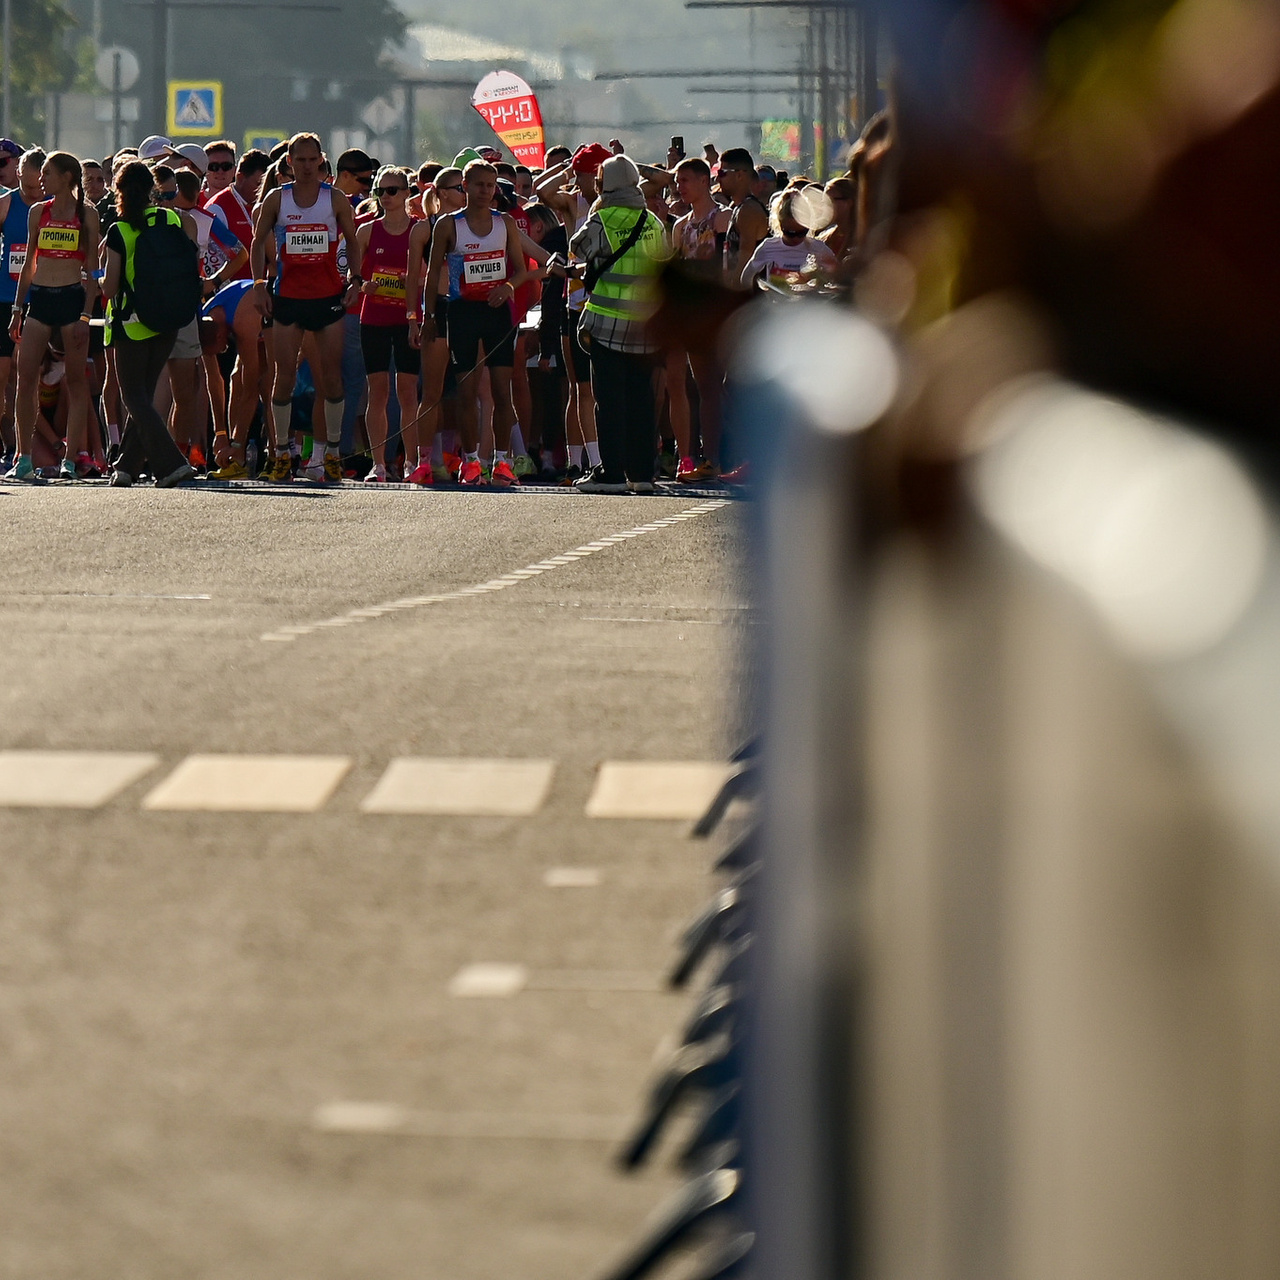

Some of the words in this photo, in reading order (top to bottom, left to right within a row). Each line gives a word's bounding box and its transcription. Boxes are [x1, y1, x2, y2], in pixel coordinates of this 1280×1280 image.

[42, 231, 75, 242] ТРОПИНА
[291, 234, 324, 245] ЛЕЙМАН
[469, 262, 501, 275] ЯКУШЕВ
